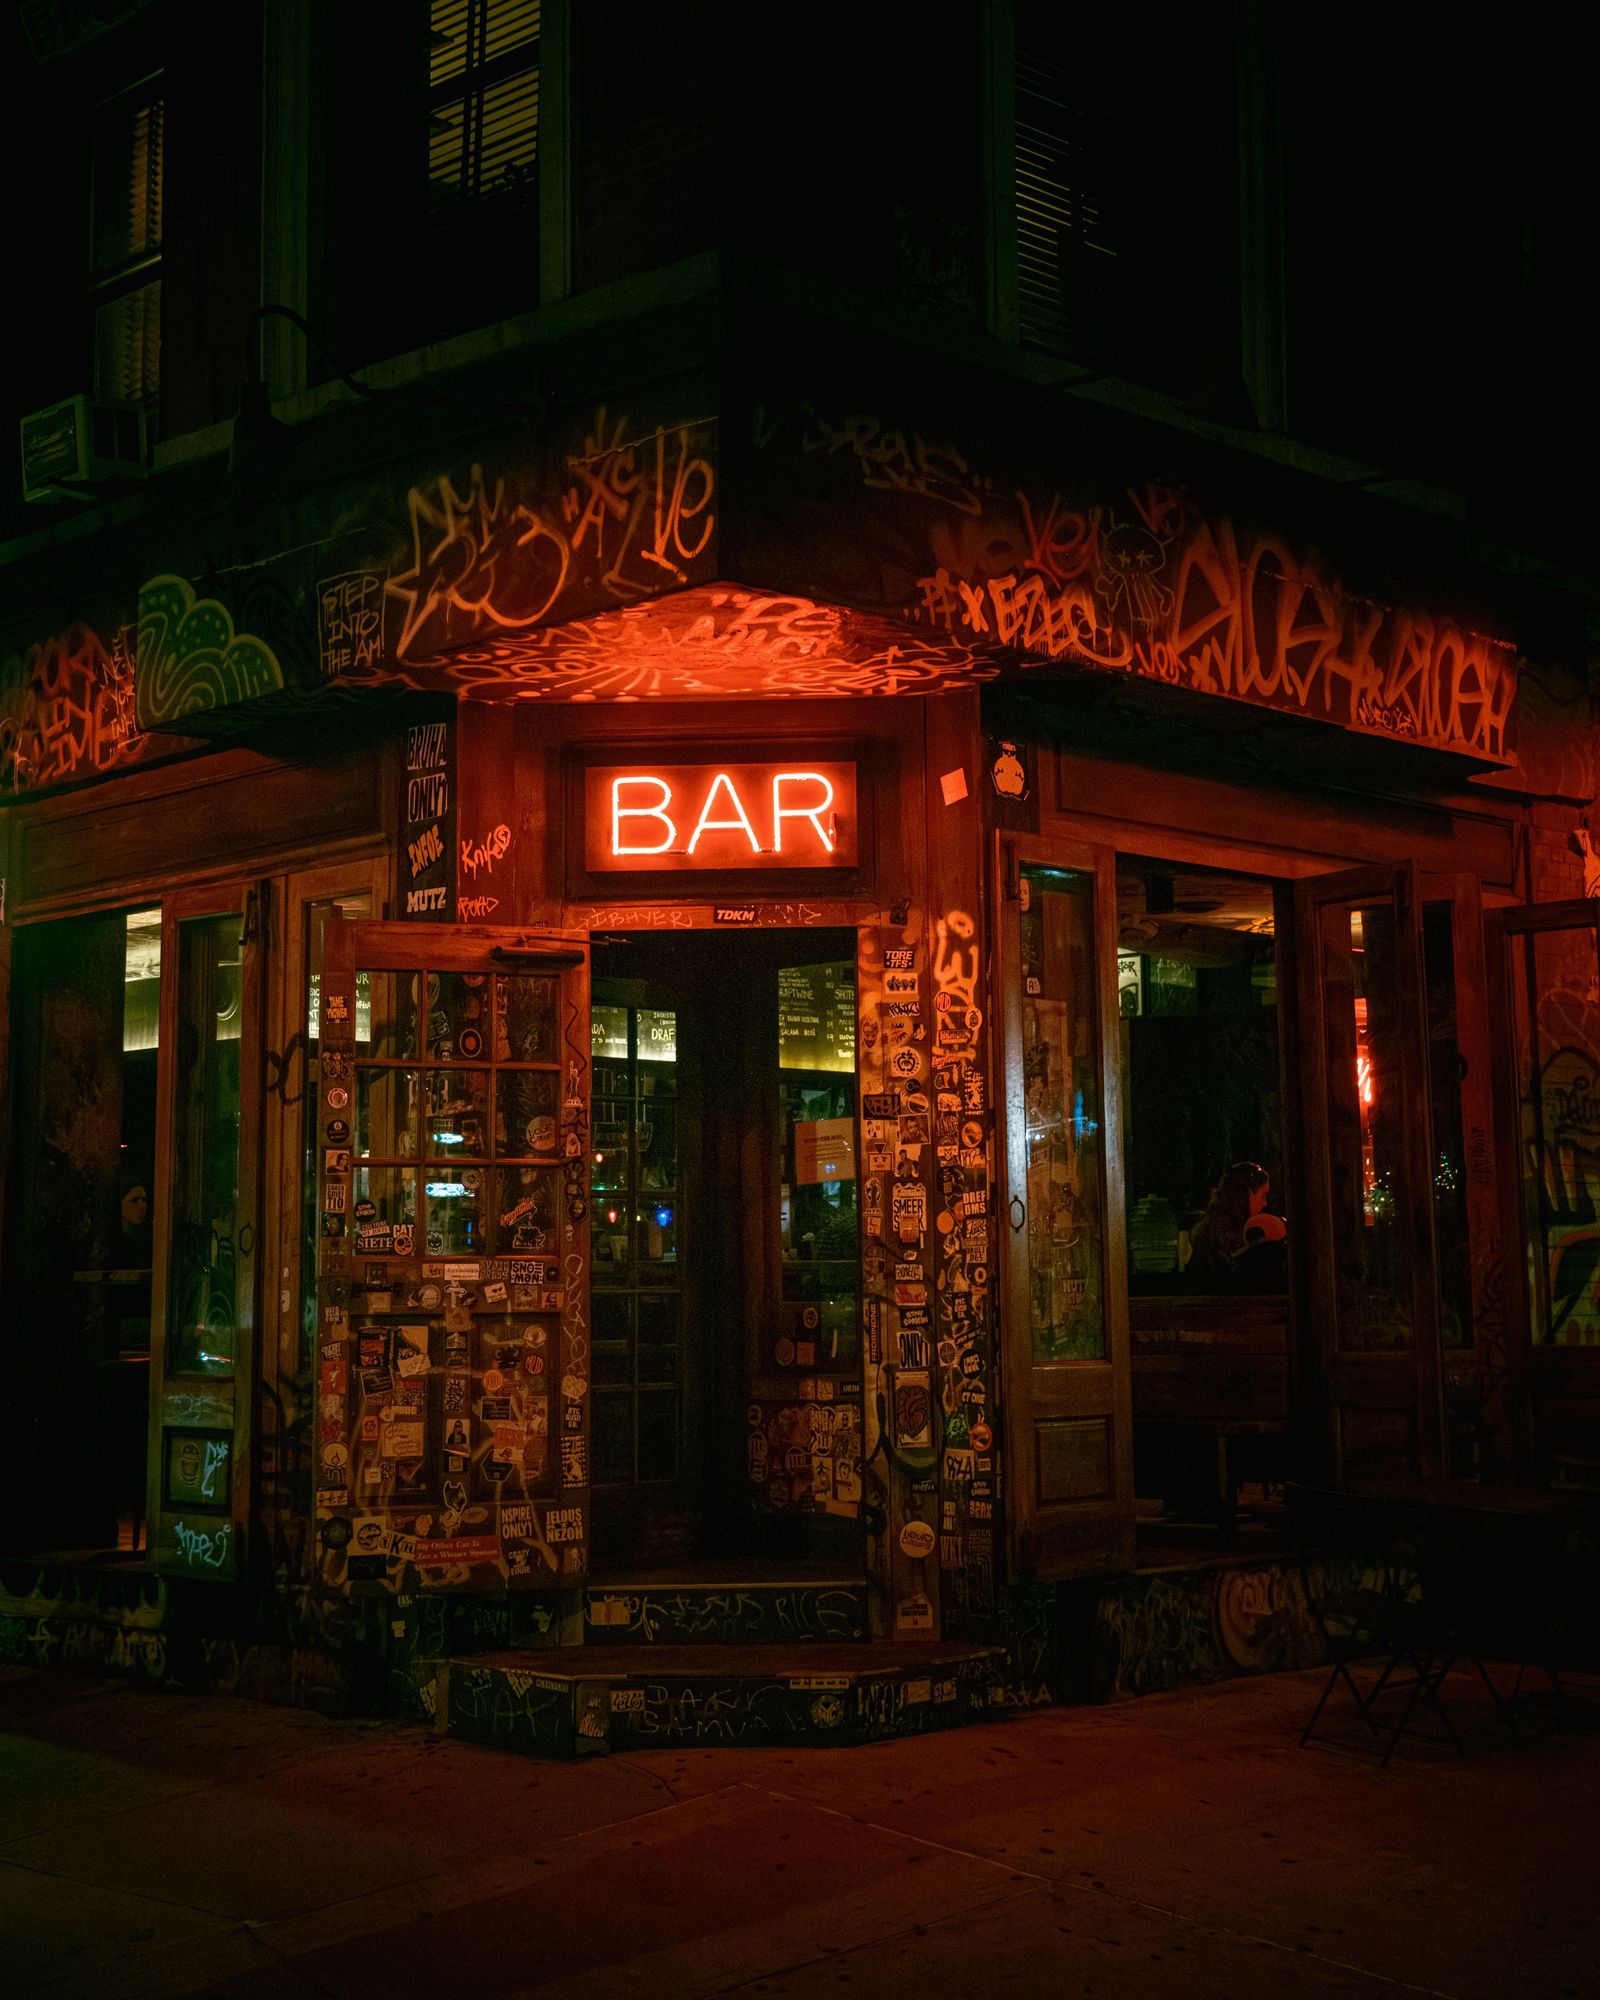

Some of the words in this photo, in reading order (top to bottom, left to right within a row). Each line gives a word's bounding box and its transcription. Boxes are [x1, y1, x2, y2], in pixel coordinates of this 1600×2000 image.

[322, 575, 380, 610] STEP
[328, 610, 379, 644] INTO
[321, 647, 355, 676] THE
[612, 773, 834, 855] BAR
[407, 887, 447, 912] MUTZ
[716, 909, 756, 921] TDKM
[885, 951, 913, 959] TORE
[890, 959, 909, 968] TFS
[893, 1200, 923, 1214] SMEER
[357, 1238, 393, 1248] SIETE
